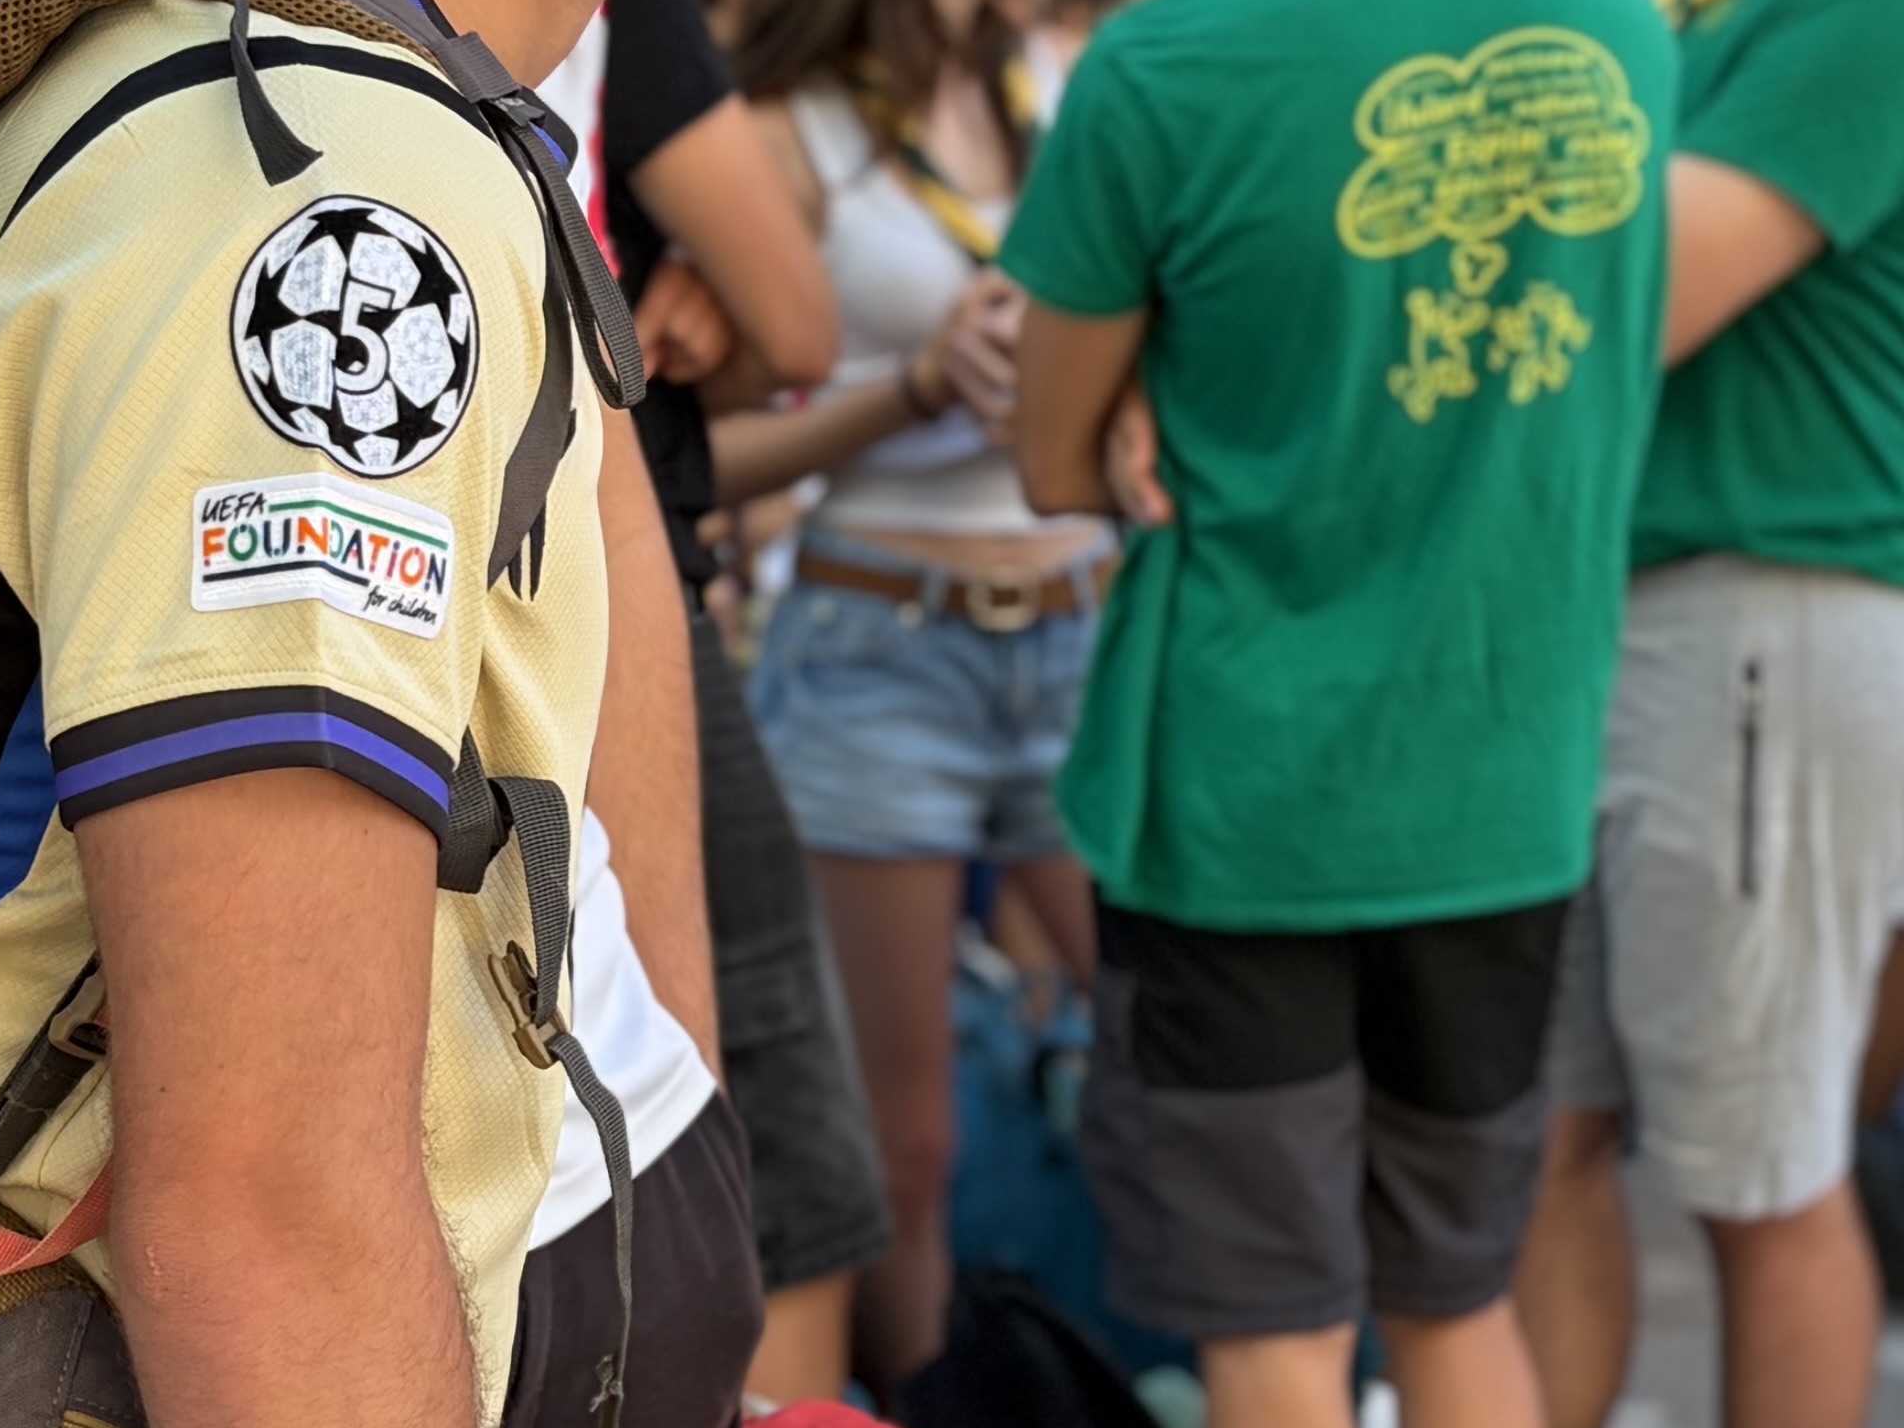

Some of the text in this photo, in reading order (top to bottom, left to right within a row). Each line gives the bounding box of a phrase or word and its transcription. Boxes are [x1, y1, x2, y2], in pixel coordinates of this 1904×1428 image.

[332, 275, 396, 396] 5
[201, 491, 267, 523] UEFA
[202, 516, 447, 595] FOUNDATION
[362, 584, 437, 626] for children
